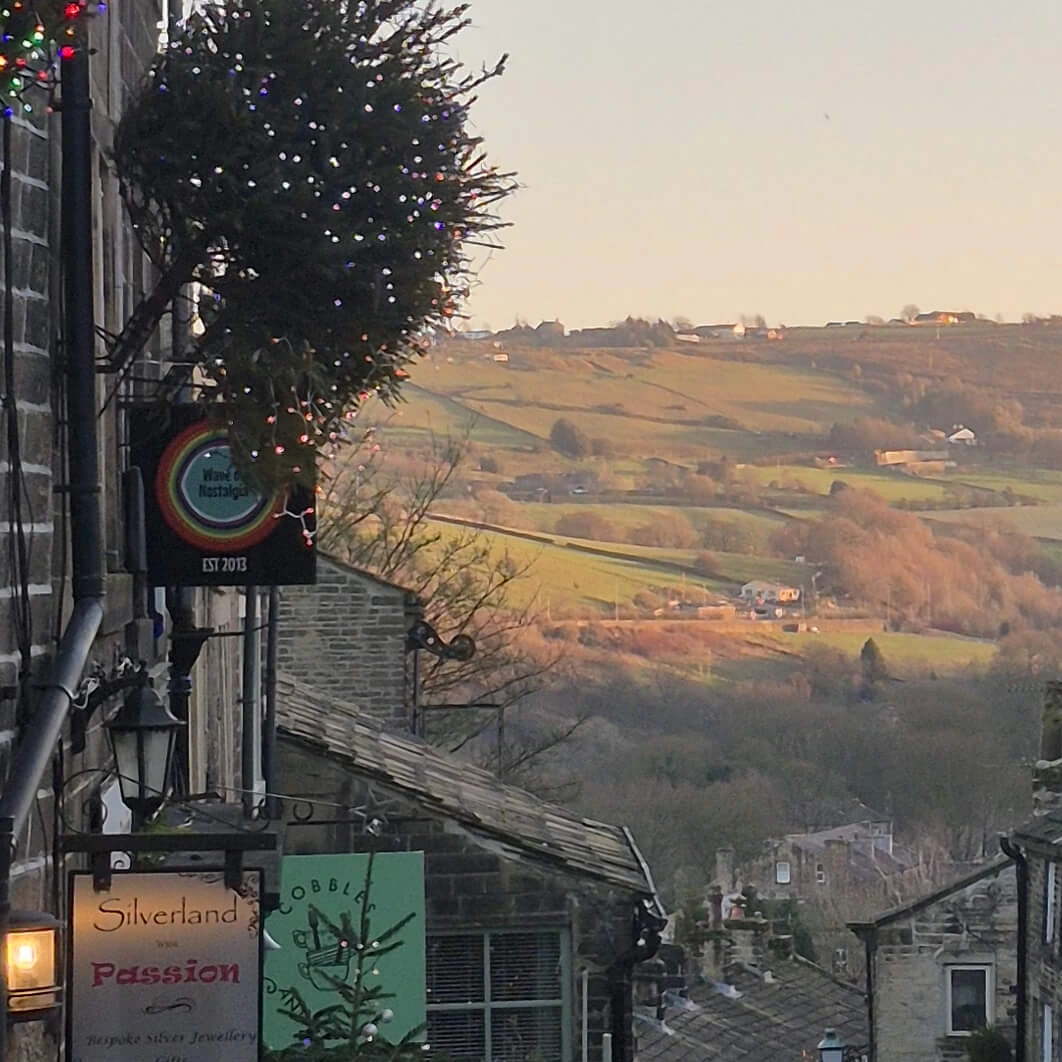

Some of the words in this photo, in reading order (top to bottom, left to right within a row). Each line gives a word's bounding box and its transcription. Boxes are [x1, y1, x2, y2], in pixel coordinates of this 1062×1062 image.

[202, 557, 219, 573] EST
[221, 557, 248, 573] 2013
[93, 896, 238, 932] Silverland
[91, 959, 241, 988] Passion
[86, 1031, 140, 1049] Bespoke
[145, 1029, 185, 1045] Silver
[189, 1027, 258, 1045] Jewellery
